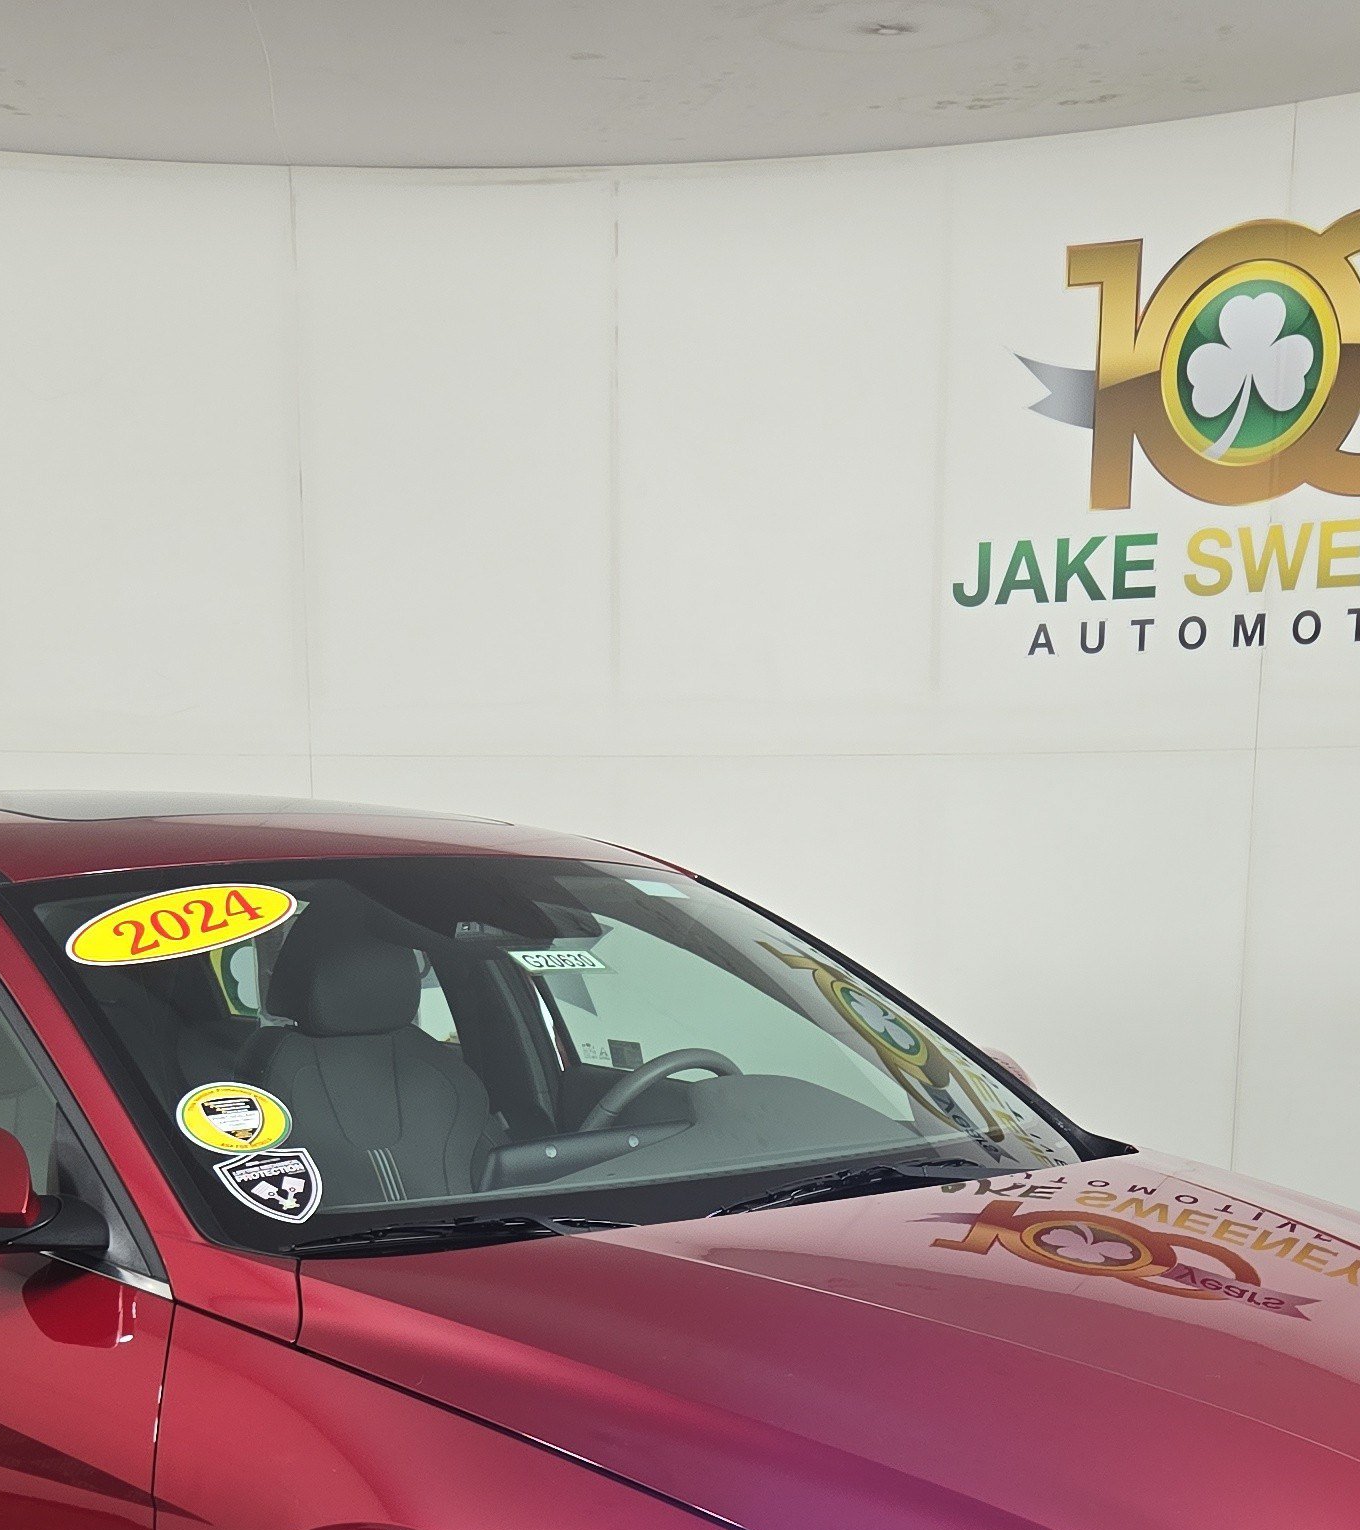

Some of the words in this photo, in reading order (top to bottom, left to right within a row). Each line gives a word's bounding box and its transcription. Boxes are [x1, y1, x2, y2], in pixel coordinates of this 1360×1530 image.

[952, 532, 1159, 608] JAKE
[113, 890, 265, 955] 2024
[522, 953, 596, 968] G20630
[234, 1163, 305, 1183] PROTECTION
